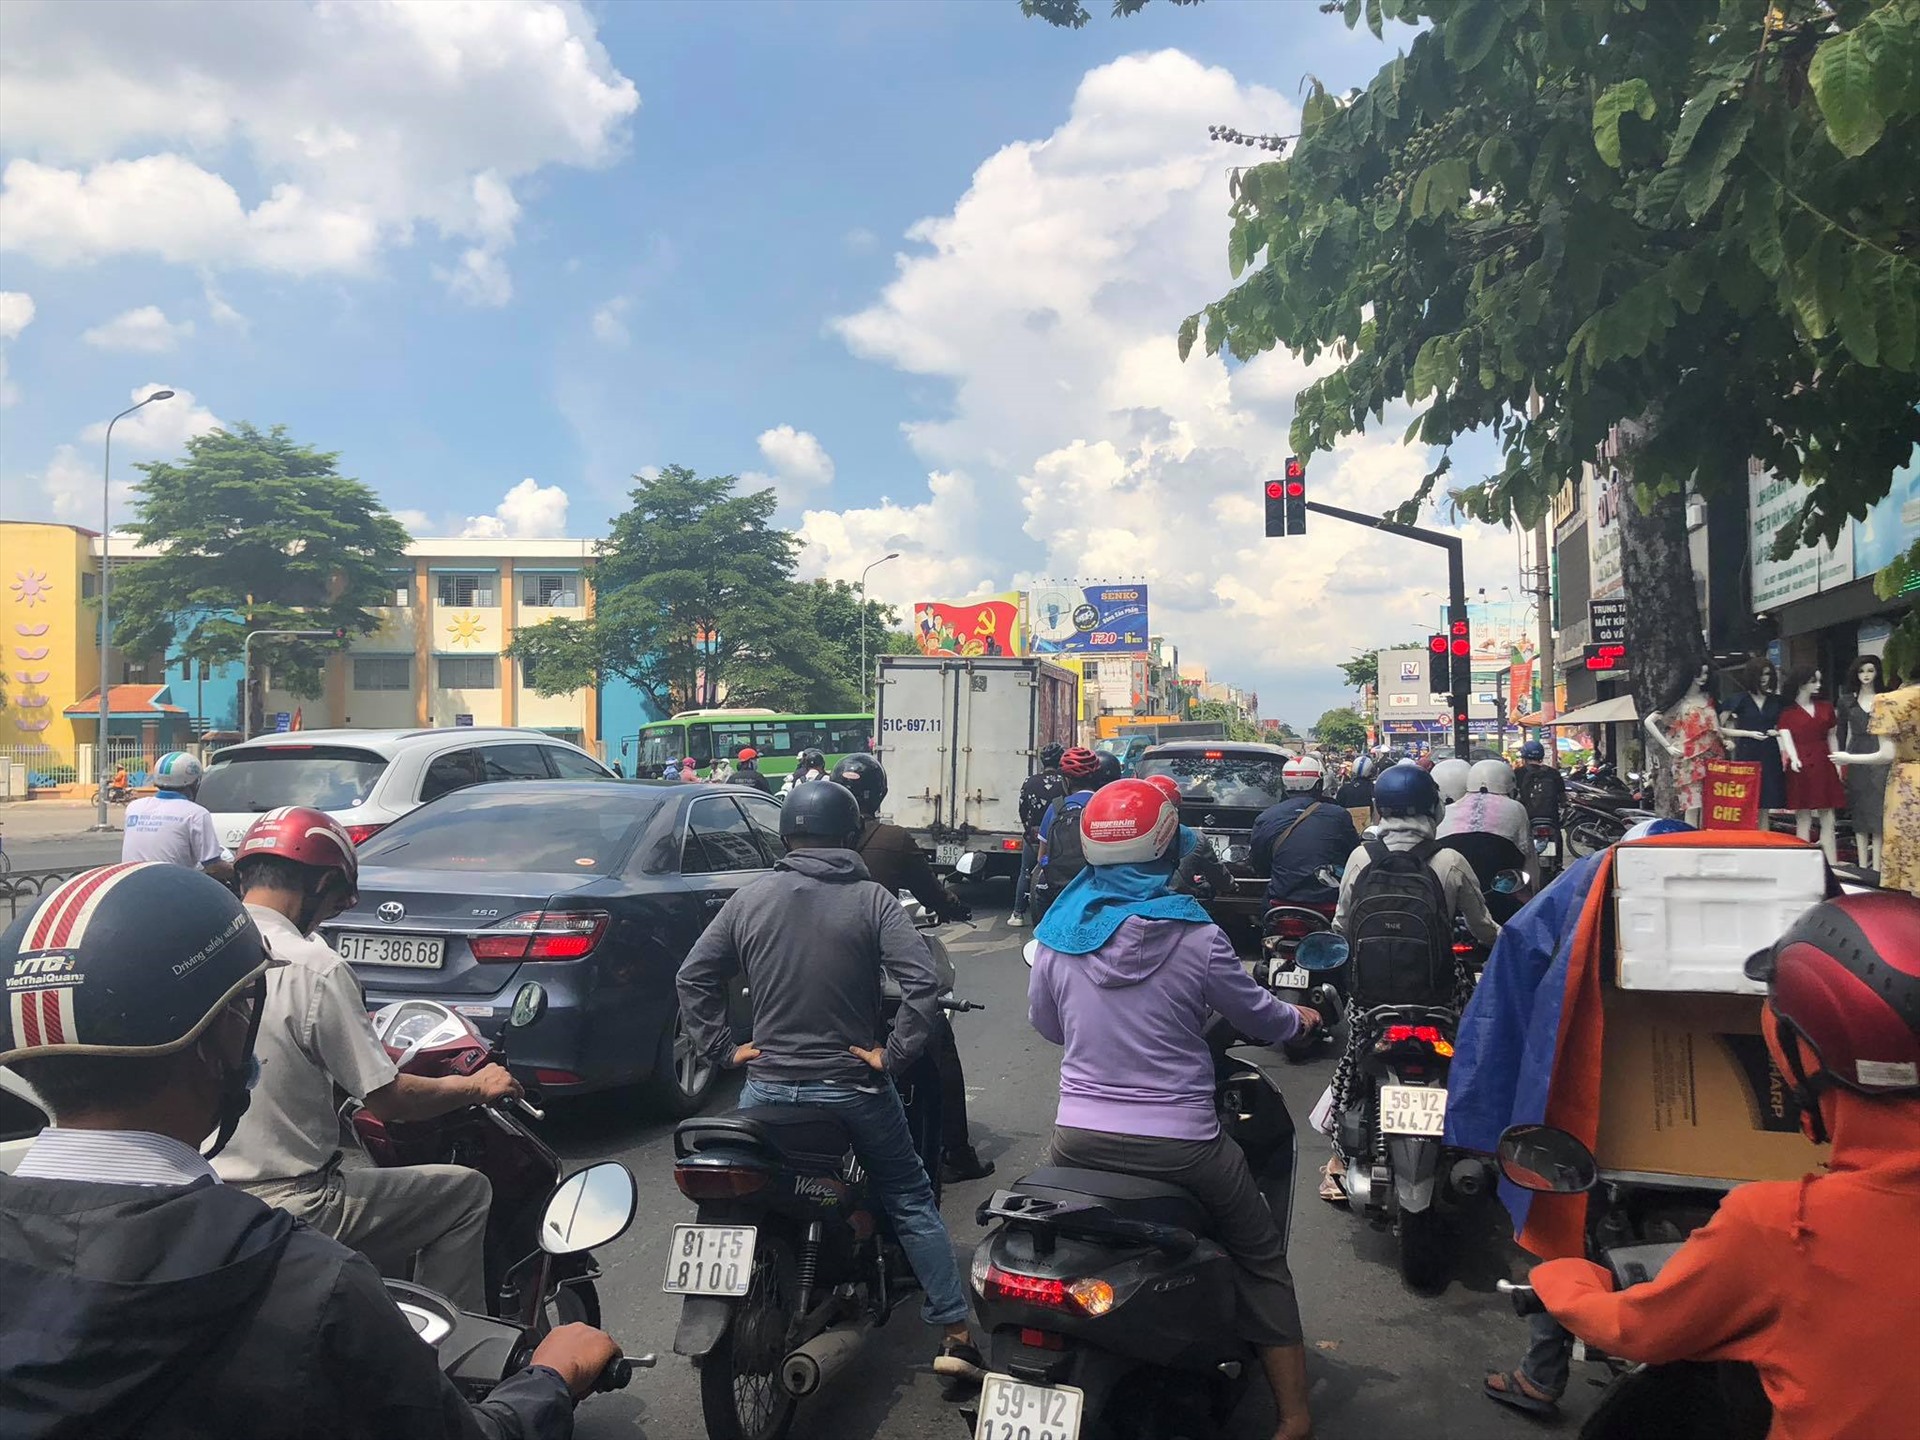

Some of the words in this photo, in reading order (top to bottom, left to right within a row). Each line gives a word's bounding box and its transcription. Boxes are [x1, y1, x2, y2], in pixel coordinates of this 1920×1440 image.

[1101, 592, 1139, 600] SENKO
[1593, 604, 1617, 614] TRUNG
[1090, 632, 1117, 644] F20
[1600, 628, 1612, 640] GÒ
[883, 718, 941, 732] 51C-697.11
[943, 846, 958, 856] 51C
[172, 951, 206, 976] Driving
[205, 935, 225, 954] safely
[340, 938, 440, 965] 51F-386.68
[1768, 1060, 1785, 1118] HARP
[1391, 1091, 1440, 1111] 59-V2
[1385, 1111, 1444, 1132] 544.72
[795, 1175, 836, 1197] Wave
[682, 1230, 743, 1259] 81-F5
[677, 1261, 739, 1290] 8100
[996, 1382, 1067, 1428] 59-V2
